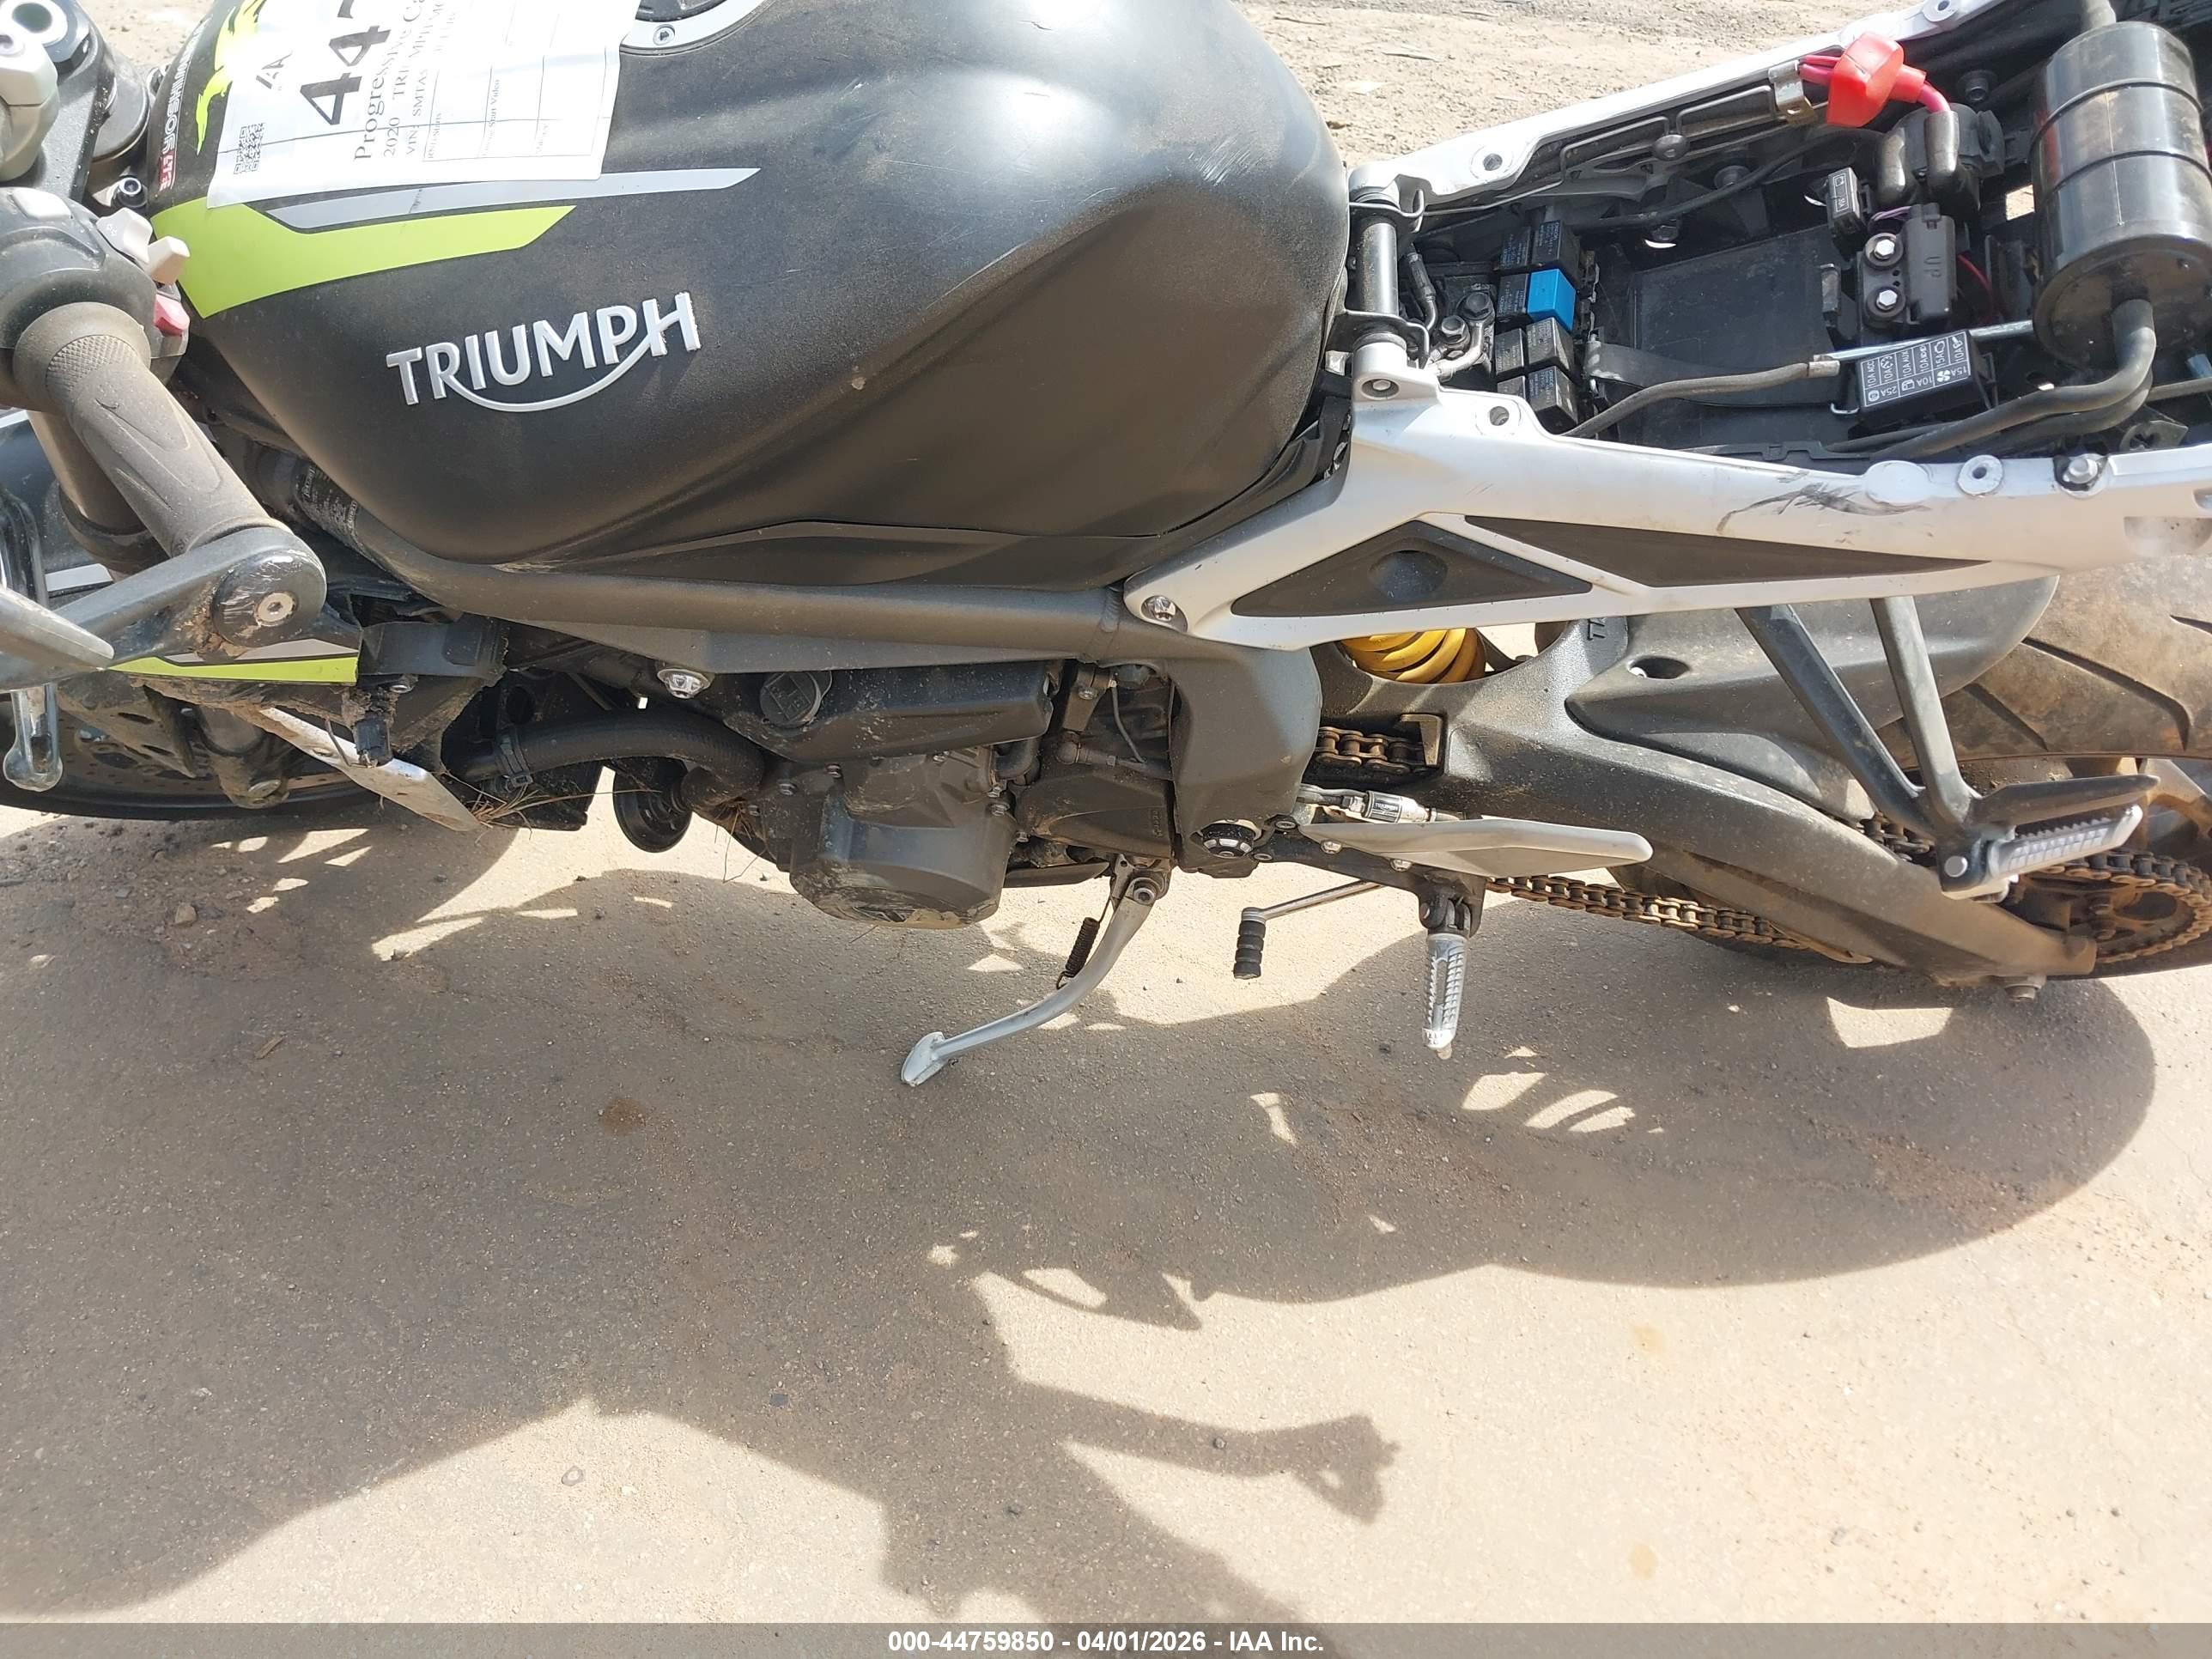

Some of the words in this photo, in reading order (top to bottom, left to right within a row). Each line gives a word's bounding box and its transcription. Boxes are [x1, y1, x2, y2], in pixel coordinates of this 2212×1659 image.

[383, 117, 401, 157] 2020
[386, 292, 701, 412] TRIUMPH
[1902, 349, 1911, 362] AUX
[1954, 347, 1965, 362] 10A
[1867, 360, 1875, 372] ACC
[1920, 356, 1929, 372] 10A
[1936, 352, 1946, 368] 15A
[1884, 366, 1894, 382] 10A
[1903, 362, 1912, 376] 10A
[1950, 366, 1967, 376] 15A
[1868, 372, 1876, 387] 10A
[1916, 375, 1932, 386] 10A
[1881, 386, 1898, 397] 25A
